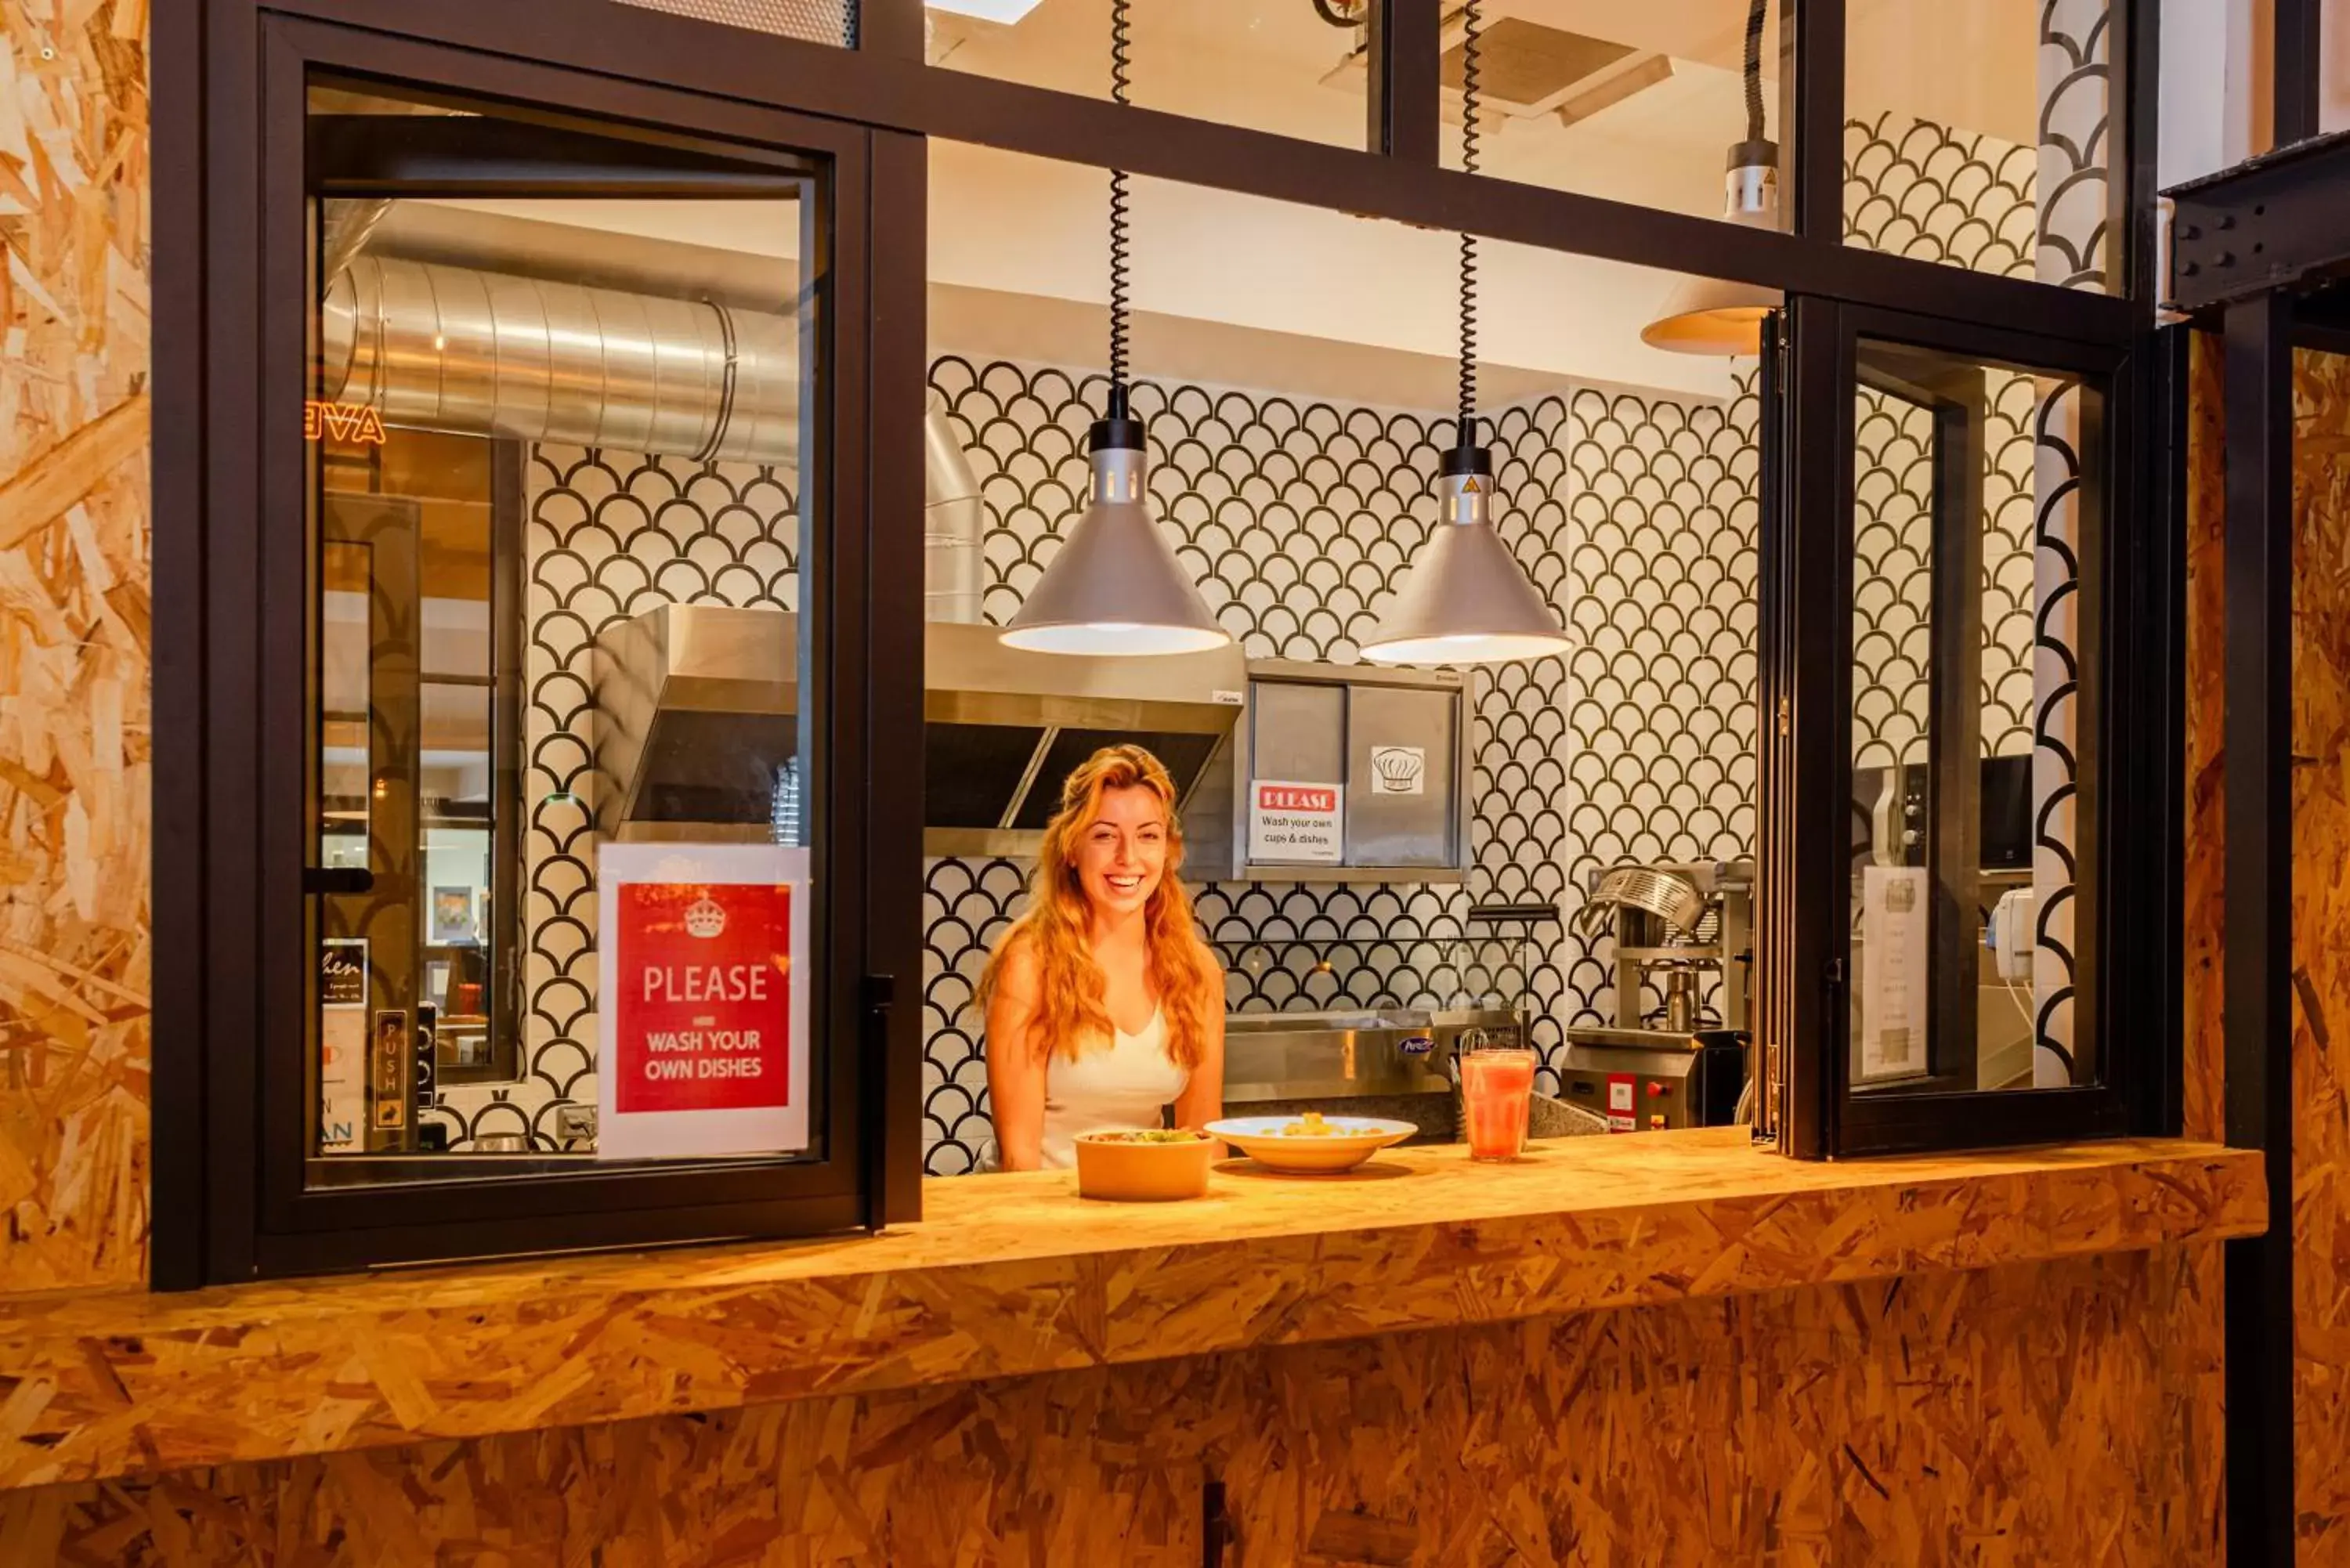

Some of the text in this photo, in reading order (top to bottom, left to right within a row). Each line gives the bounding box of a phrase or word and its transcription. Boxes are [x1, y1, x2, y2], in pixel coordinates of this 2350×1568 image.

[1264, 792, 1330, 809] PLEASE
[1262, 816, 1289, 826] Wash
[1290, 819, 1311, 829] your
[1264, 833, 1329, 845] cups & dishes
[644, 965, 767, 1002] PLEASE
[646, 1031, 761, 1052] WASH YOUR
[385, 1024, 396, 1091] PUSH
[645, 1057, 762, 1080] OWN DISHES
